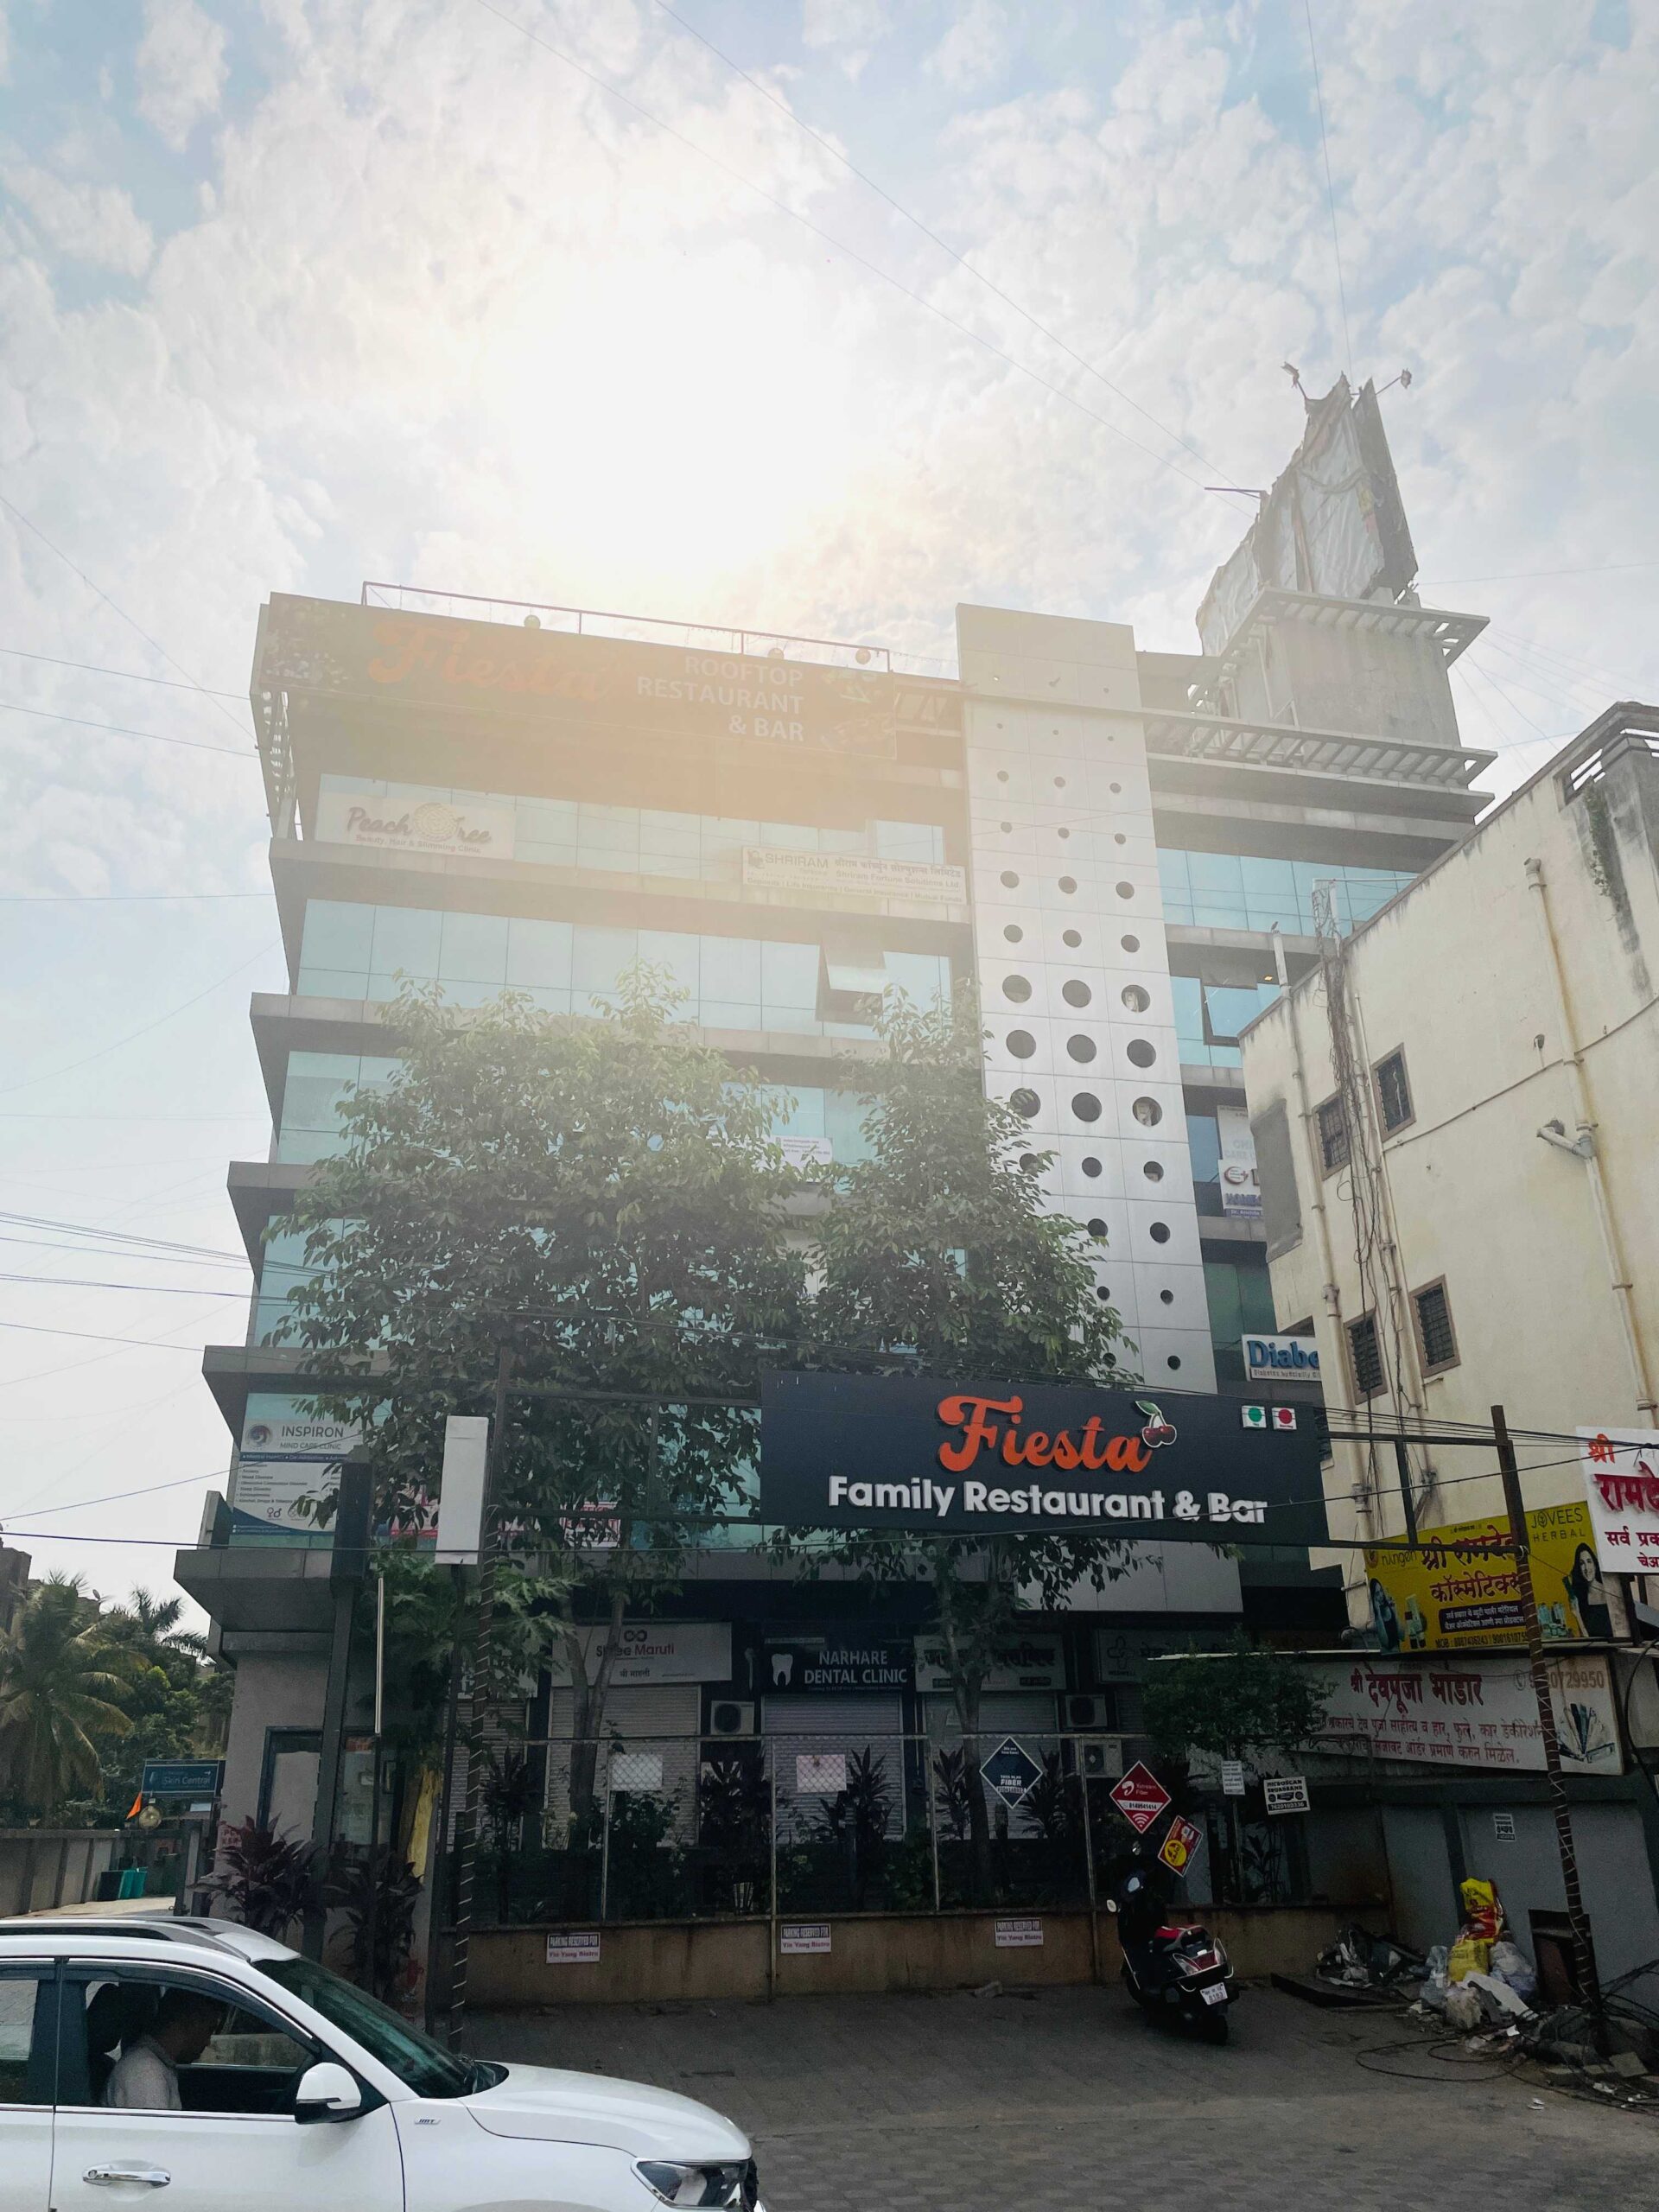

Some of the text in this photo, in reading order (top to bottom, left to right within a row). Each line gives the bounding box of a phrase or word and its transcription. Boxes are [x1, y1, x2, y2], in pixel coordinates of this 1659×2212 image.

[367, 621, 608, 702] Fiesta
[684, 655, 803, 688] ROOFTOP
[636, 677, 804, 715] RESTAURANT
[728, 715, 804, 742] & BAR
[346, 806, 415, 836] Peach
[765, 851, 830, 869] SHRIRAM
[836, 869, 869, 880] Shriram
[871, 872, 904, 883] Fortune
[281, 1426, 344, 1439] INSPIRON
[938, 1395, 1153, 1473] Fiesta
[279, 1441, 298, 1450] MIND
[1588, 1433, 1616, 1465] श्री
[828, 1475, 1268, 1523] Family Restaurant & Bar
[1531, 1508, 1584, 1529] JOVEES
[1534, 1528, 1586, 1543] HERBAL
[1605, 1525, 1631, 1547] सर्व
[596, 1643, 676, 1657] See Maruti
[819, 1650, 889, 1666] NARHARE
[804, 1669, 908, 1684] DENTAL CLINIC
[181, 1776, 211, 1786] Central
